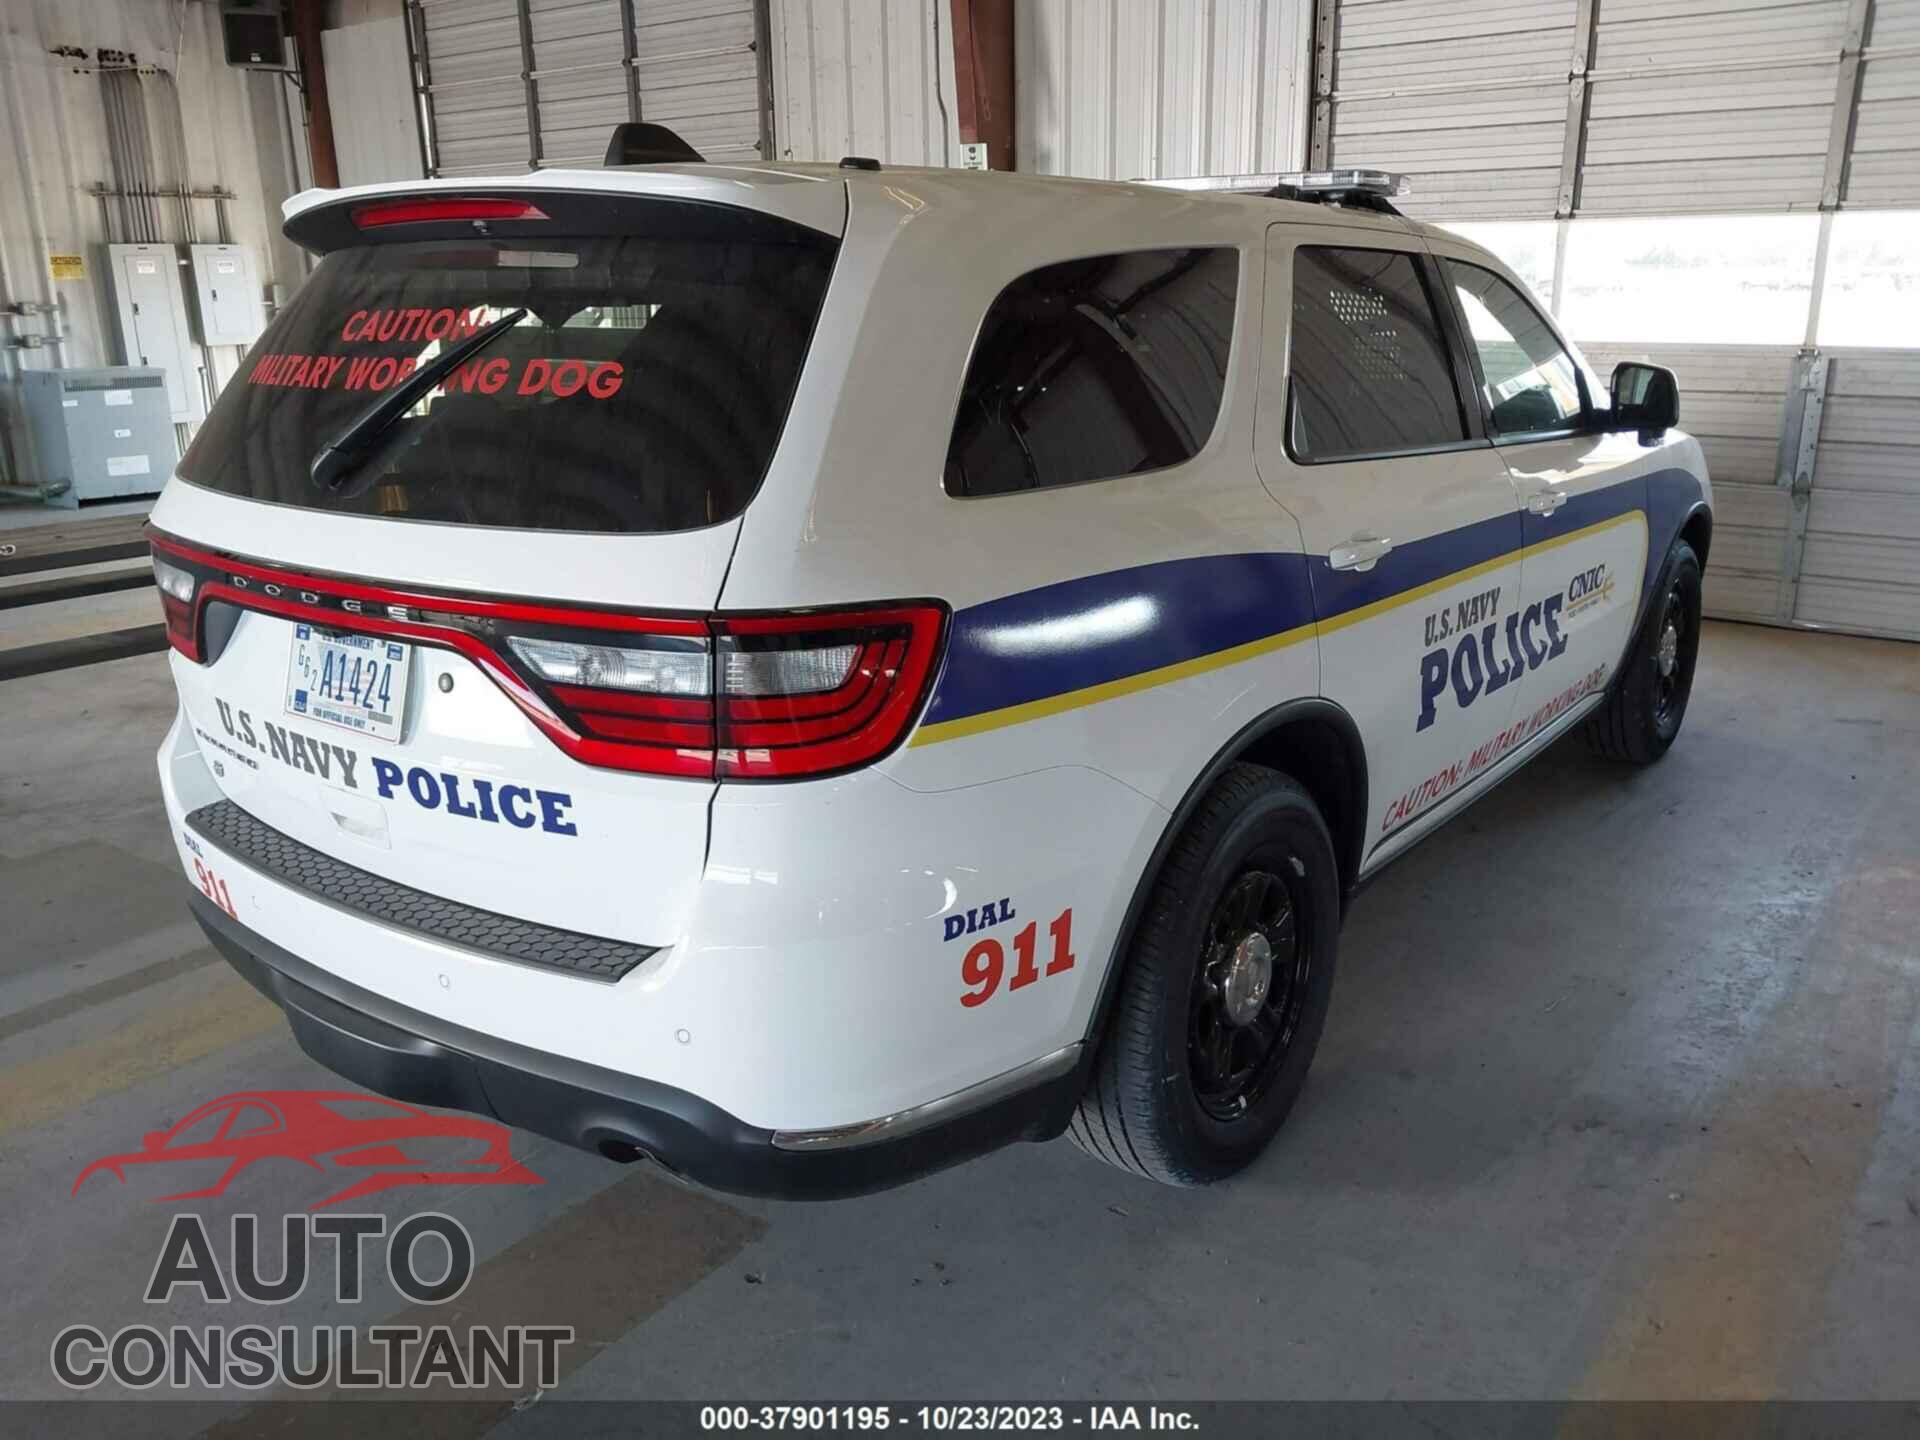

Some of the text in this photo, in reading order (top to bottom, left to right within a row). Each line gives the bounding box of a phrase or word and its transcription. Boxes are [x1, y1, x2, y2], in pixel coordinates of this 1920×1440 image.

[247, 354, 347, 390] MILITARY
[517, 357, 625, 399] DOG
[233, 575, 409, 621] DODGE
[1568, 563, 1606, 602] CNIC
[1424, 586, 1501, 647] U.S. NAVY
[319, 650, 392, 713] A1424
[1416, 591, 1569, 733] POLICE
[215, 696, 266, 754] U.S.
[263, 720, 359, 789] NAVY
[371, 757, 578, 837] POLICE
[194, 858, 239, 920] 911
[943, 898, 1016, 942] DIAL
[960, 908, 1075, 1008] 911
